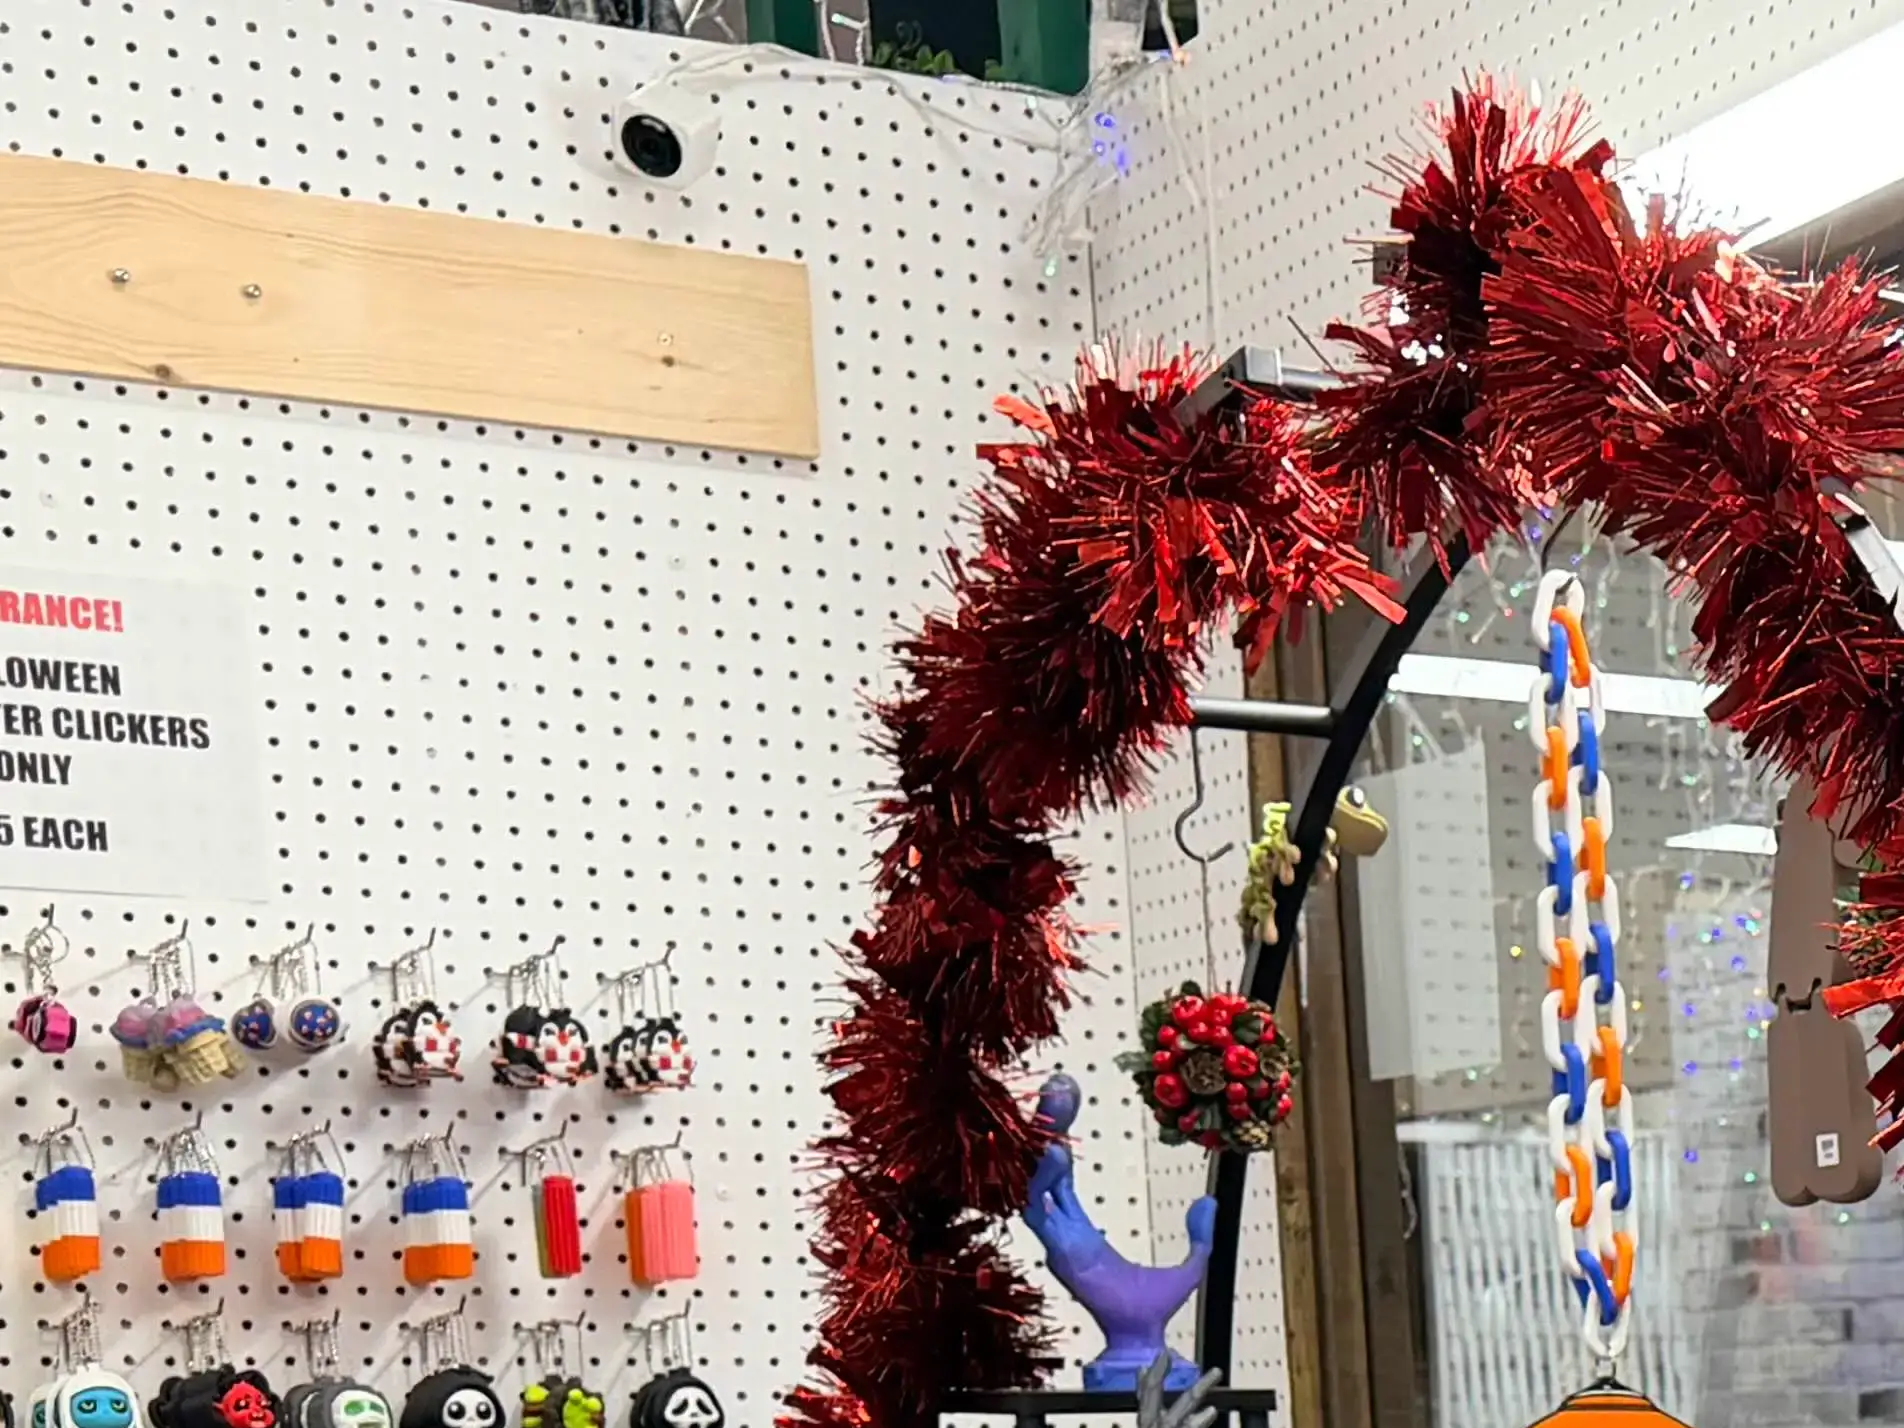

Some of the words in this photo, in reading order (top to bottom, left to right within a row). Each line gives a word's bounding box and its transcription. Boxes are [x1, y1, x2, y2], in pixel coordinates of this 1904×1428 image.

[0, 589, 124, 633] RANCE!
[0, 656, 121, 696] OWEEN
[0, 703, 44, 737] ER
[52, 707, 210, 749] CLICKERS
[23, 816, 109, 852] EACH
